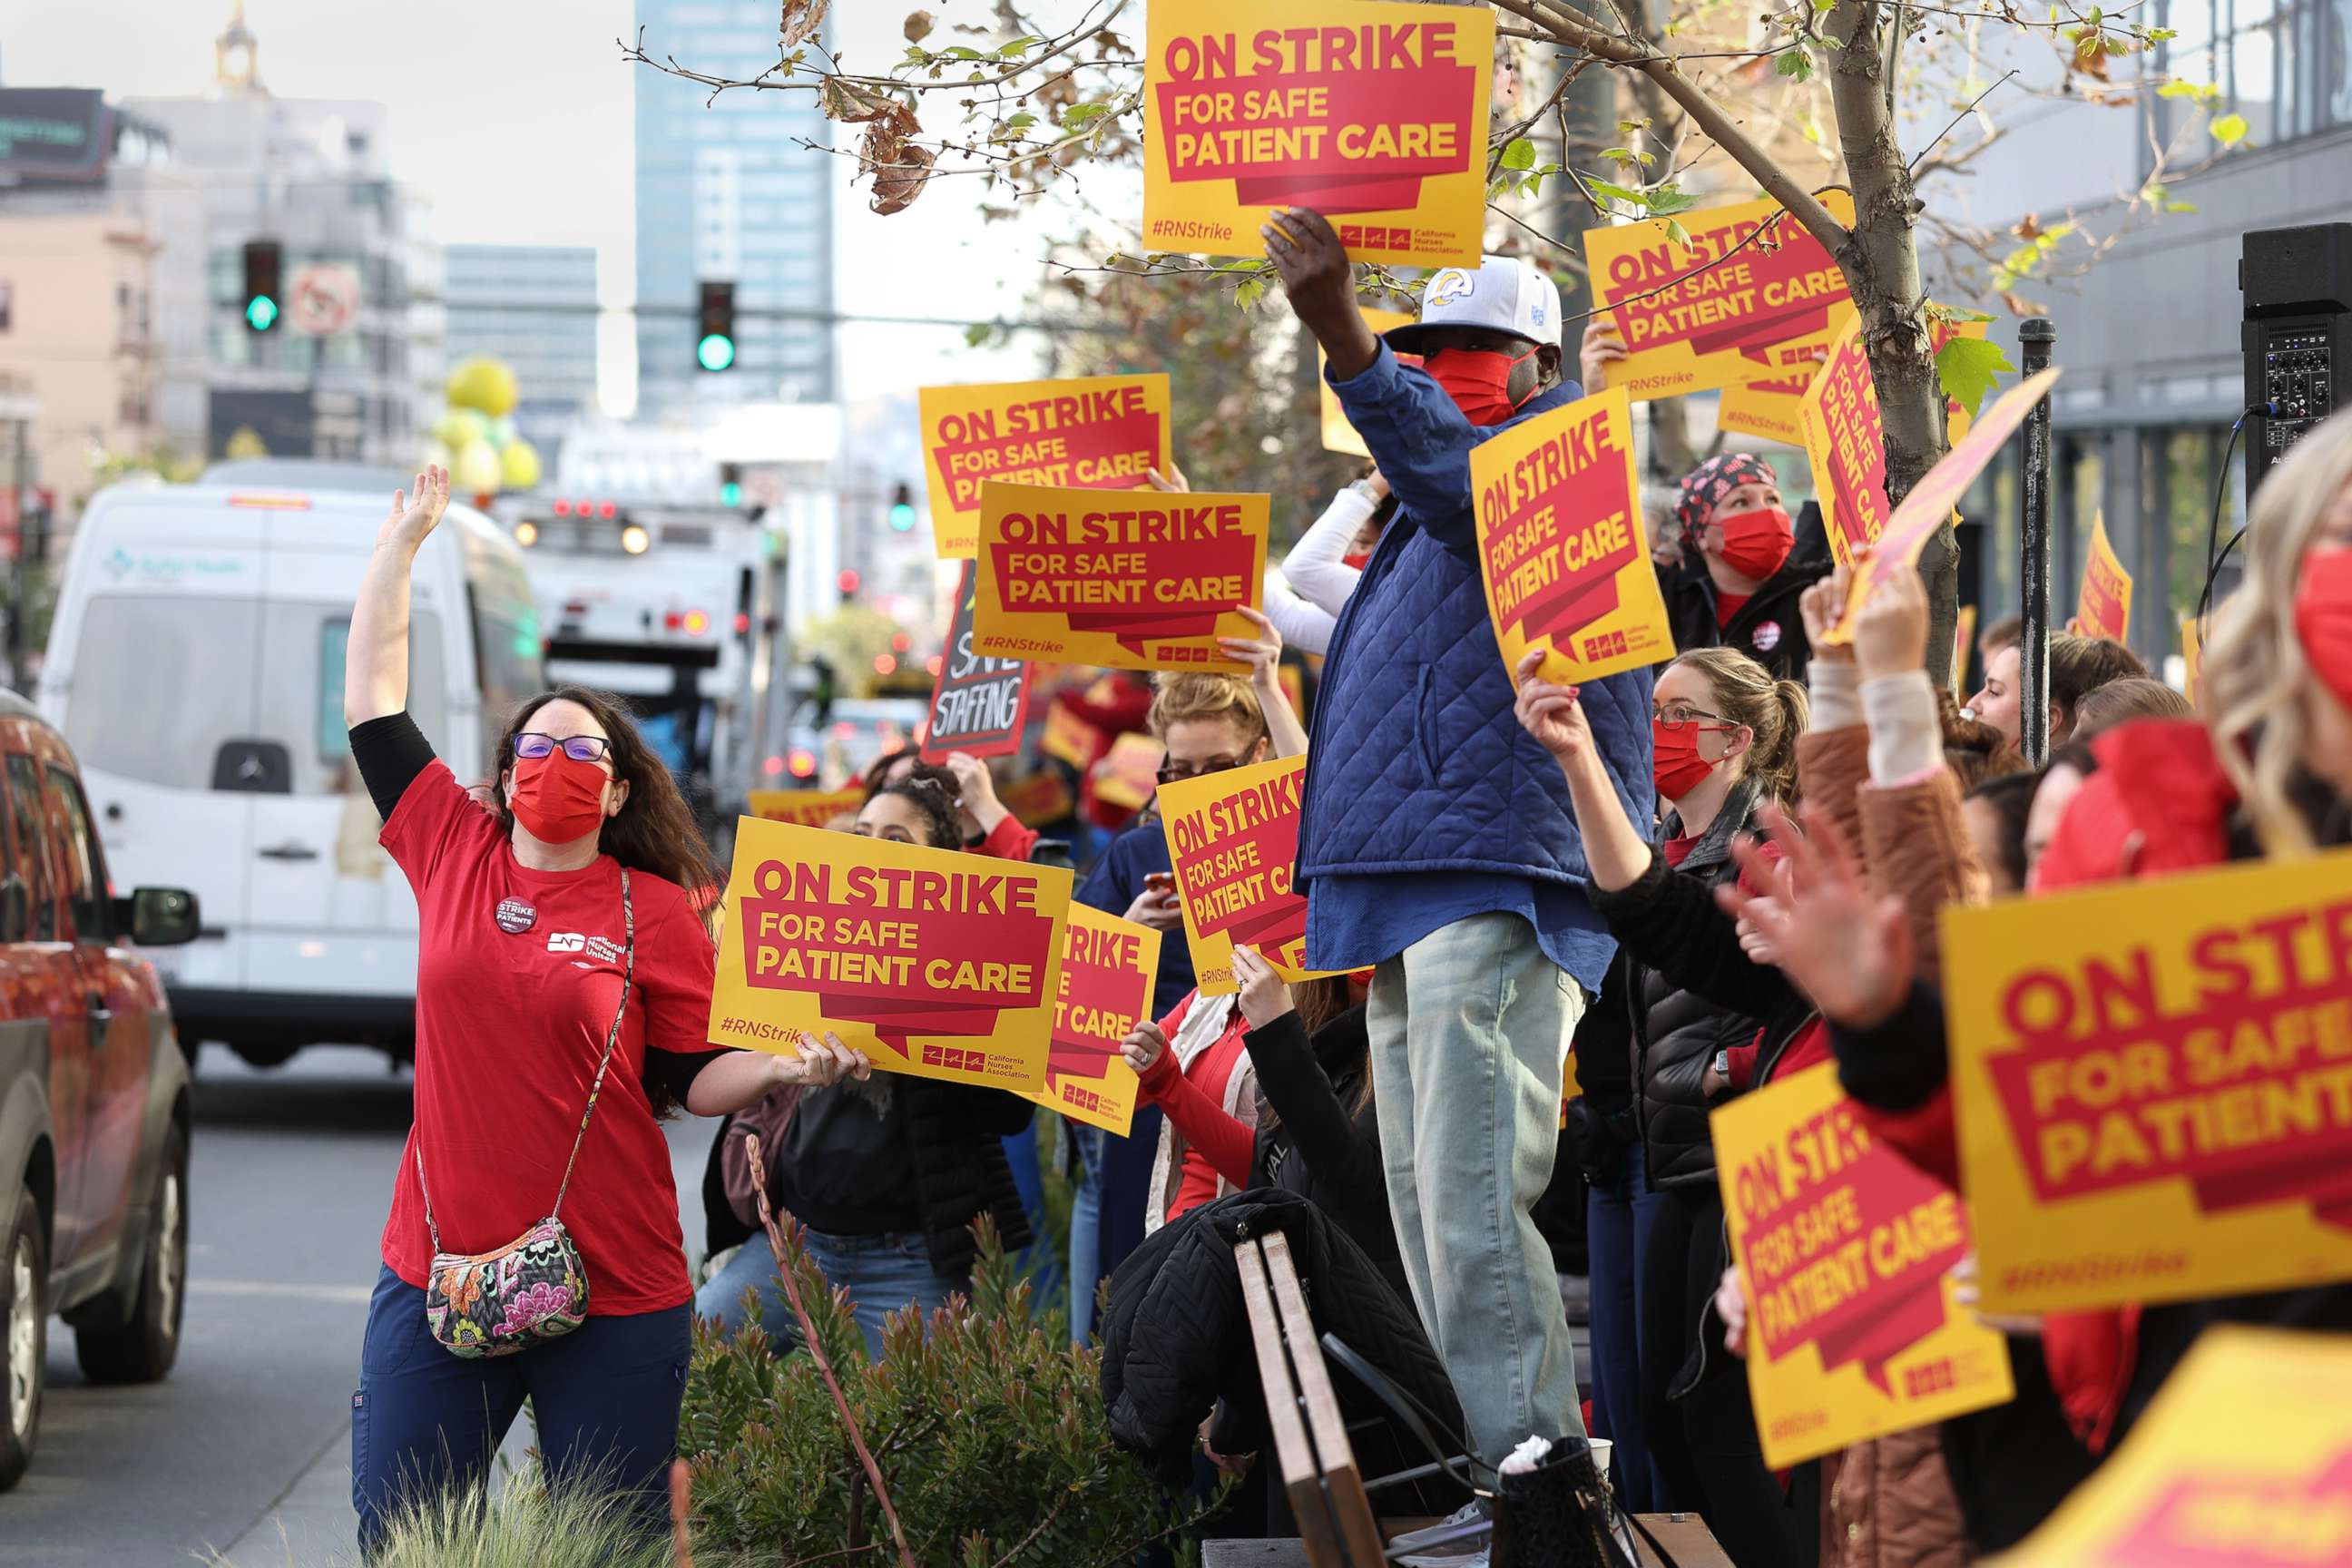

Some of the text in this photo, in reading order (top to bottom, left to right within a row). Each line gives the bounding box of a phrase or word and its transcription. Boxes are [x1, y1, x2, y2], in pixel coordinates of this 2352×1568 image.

[1165, 23, 1455, 83] ON STRIKE
[1175, 87, 1328, 125] FOR SAFE
[1176, 122, 1456, 167] PATIENT CARE
[1152, 219, 1232, 241] #RNStrike
[1415, 229, 1455, 239] California
[1415, 238, 1443, 246] Nurses
[1609, 201, 1828, 286] ON STRIK
[1414, 246, 1464, 255] Association
[1624, 262, 1753, 316] FOR SAFE
[1629, 266, 1847, 343] PATIENT CARE
[938, 386, 1146, 446] ON STRIKE
[1836, 362, 1877, 473] FOR SAFE
[950, 438, 1068, 475] FOR SAFE
[1075, 451, 1151, 484] CARE
[1483, 409, 1613, 535] ON STRIKE
[1824, 382, 1883, 546] PATIENT CAR
[1000, 513, 1067, 544] ON
[1082, 505, 1241, 544] STRIKE
[1491, 504, 1557, 578] FOR SAFE
[1008, 553, 1147, 574] FOR SAFE
[1495, 510, 1630, 621] PATIENT CARE
[1008, 575, 1243, 603] PATIENT CARE
[983, 635, 1064, 653] #RNStrike
[932, 676, 1023, 737] STAFFING
[1174, 809, 1208, 857] ON
[1185, 859, 1214, 892] FOR
[1216, 840, 1261, 879] SAFE
[753, 859, 1038, 916] ON STRIKE
[1192, 872, 1265, 926] PATIENT
[496, 914, 532, 925] PATIENTS
[499, 904, 534, 916] STRIKE
[587, 941, 616, 958] Nurses
[589, 936, 626, 955] National
[759, 913, 919, 949] FOR SAFE
[1065, 923, 1141, 971] RIKE
[586, 947, 616, 964] United
[755, 946, 916, 987] PATIENT
[925, 958, 1032, 994] CARE
[1201, 965, 1234, 985] #RNStrik
[2000, 946, 2158, 1044] ON
[720, 1016, 802, 1044] #RNStrik
[1070, 1005, 1132, 1042] CARE
[986, 1068, 1030, 1079] Association
[987, 1061, 1013, 1070] Nurses
[988, 1054, 1024, 1064] California
[2028, 998, 2352, 1119] FOR SAFE
[1751, 1185, 1860, 1287] FOR SAFE
[1761, 1191, 1962, 1347] PATIENT CARE
